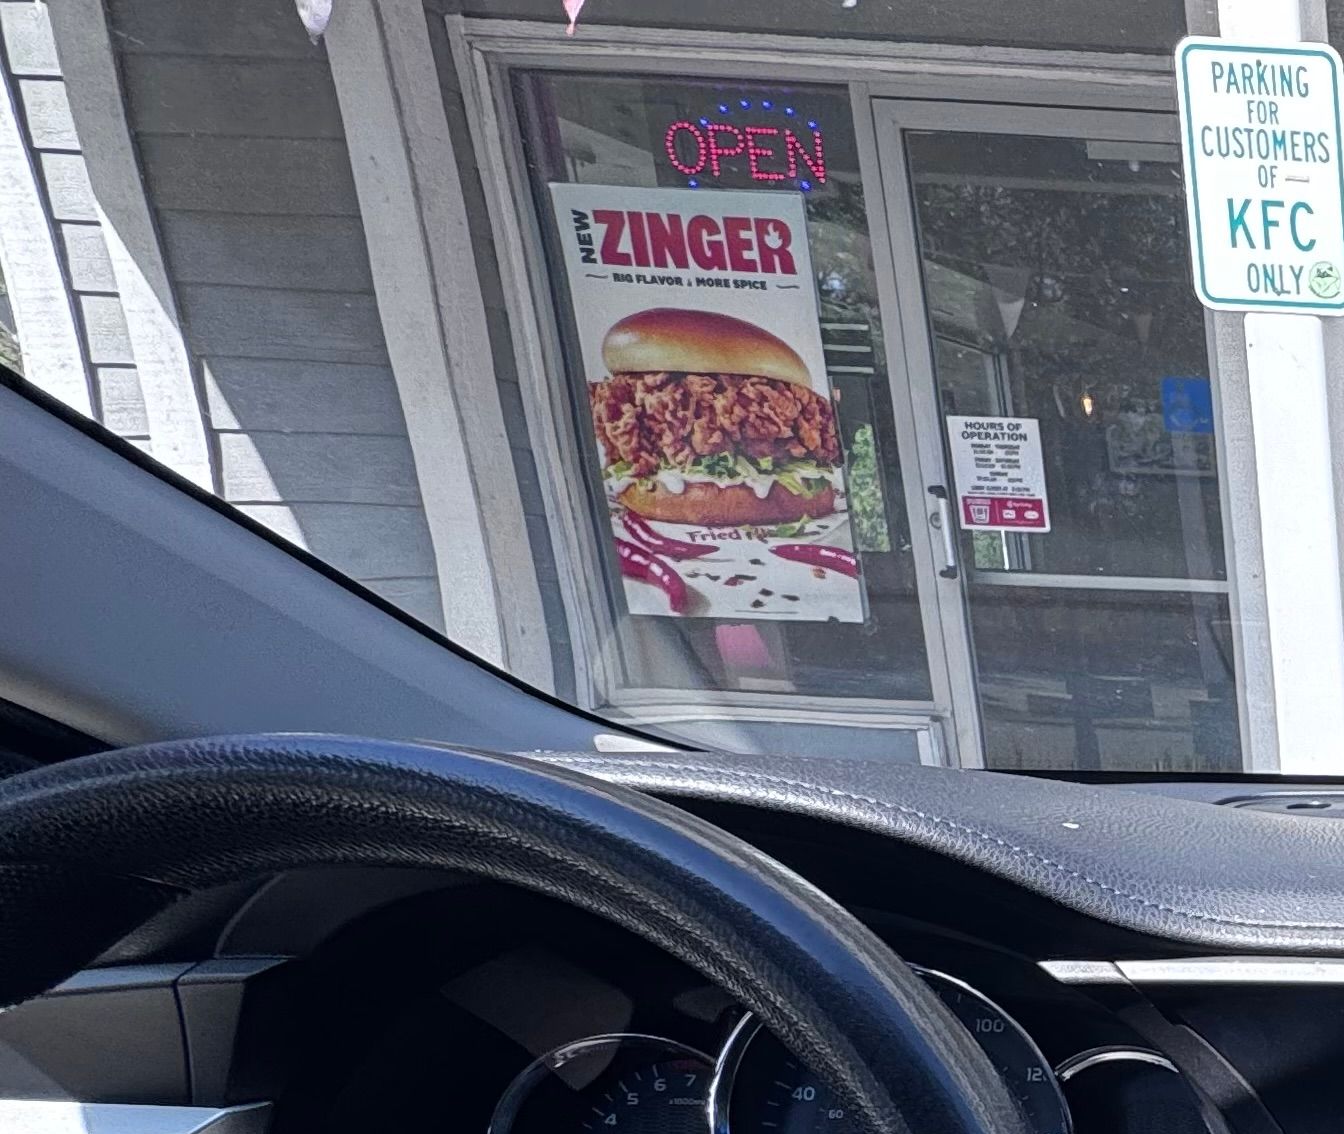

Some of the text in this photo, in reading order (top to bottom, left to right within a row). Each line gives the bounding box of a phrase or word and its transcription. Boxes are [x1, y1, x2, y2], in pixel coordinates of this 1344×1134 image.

[1211, 61, 1309, 98] PARKING
[1247, 100, 1279, 125] FOR
[665, 120, 826, 184] OPEN
[1201, 125, 1330, 163] CUSTOMERS
[1257, 165, 1278, 188] OF
[1227, 198, 1316, 252] KFC
[571, 209, 597, 264] NEW
[592, 210, 797, 275] ZINGER
[612, 272, 633, 284] BIG
[636, 274, 683, 287] FLAVOR
[696, 277, 731, 289] MORE
[733, 278, 767, 290] SPICE
[1246, 262, 1304, 296] ONLY
[965, 421, 1022, 432] HOURS OF
[961, 431, 1028, 442] OPERATION
[684, 1073, 696, 1087] 7
[1026, 1066, 1049, 1082] 12
[654, 1077, 667, 1092] 6
[791, 1085, 816, 1102] 40
[626, 1092, 639, 1106] 5
[604, 1112, 618, 1126] 4
[828, 1109, 844, 1120] 60
